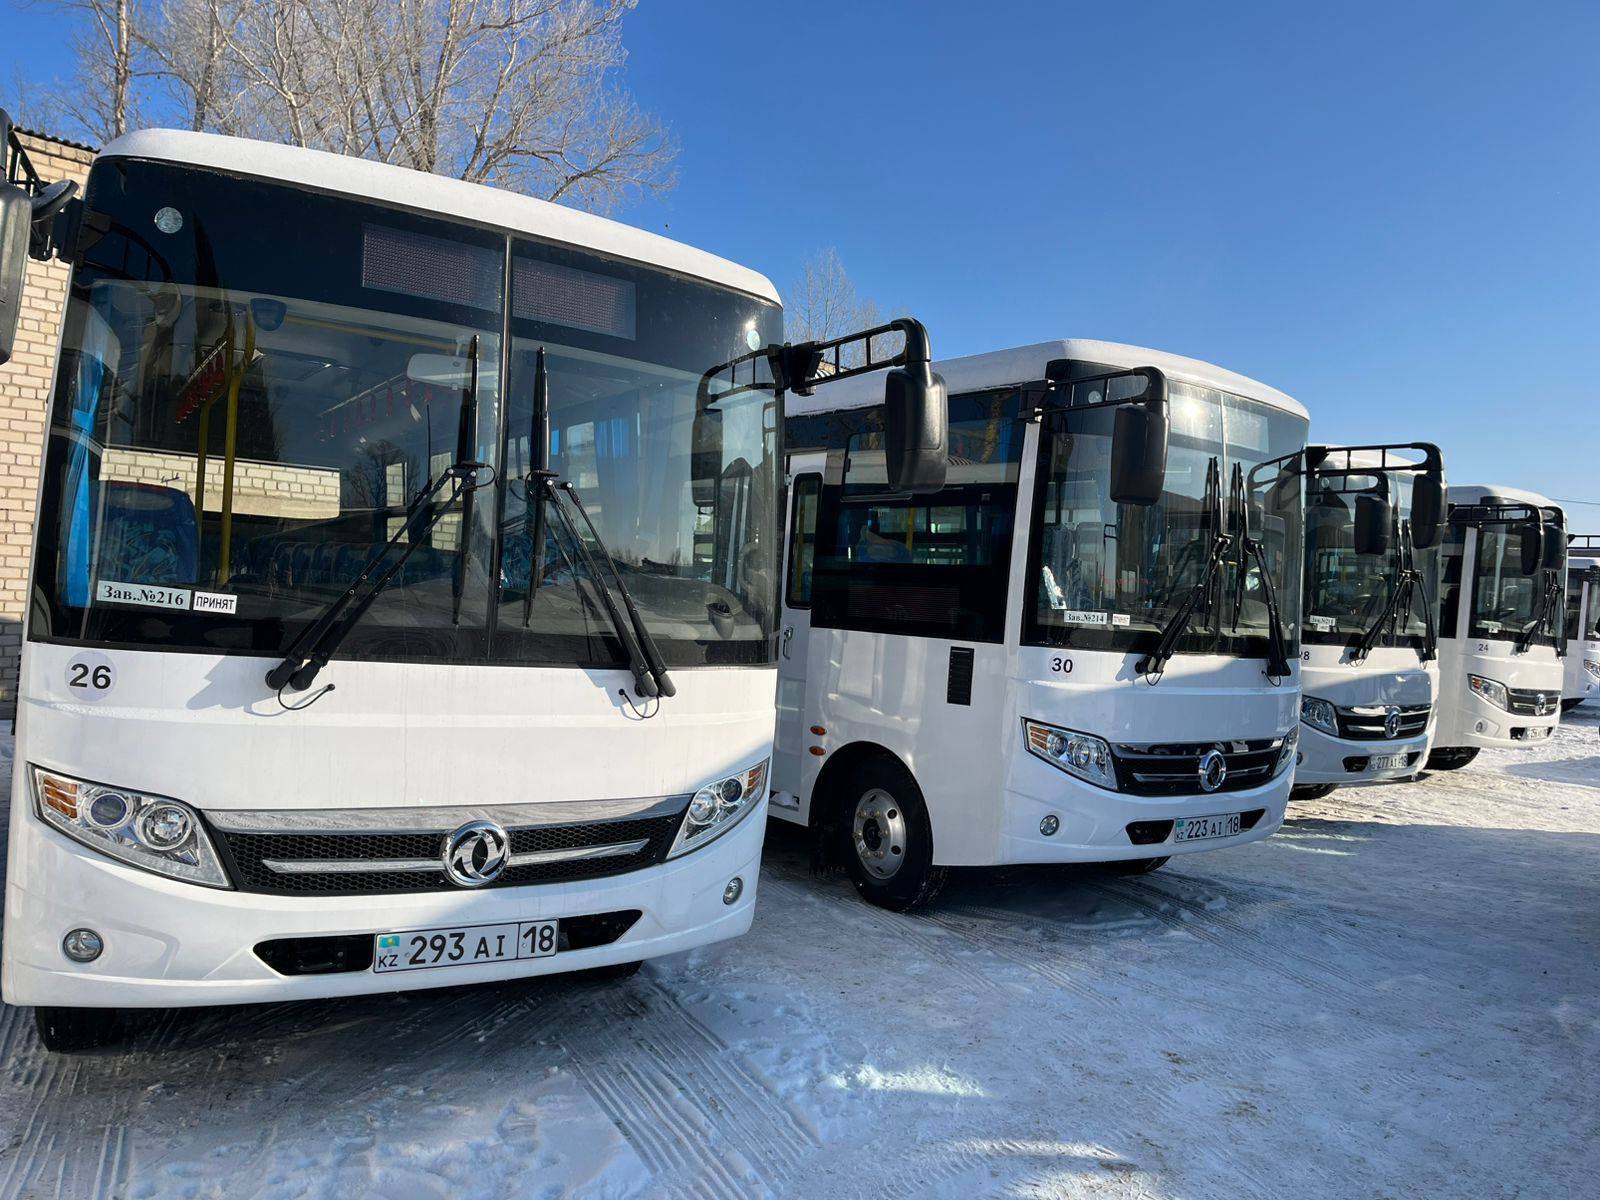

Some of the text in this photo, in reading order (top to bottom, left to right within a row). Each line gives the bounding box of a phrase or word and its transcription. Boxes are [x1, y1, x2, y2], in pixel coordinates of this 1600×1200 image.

[195, 596, 235, 610] ПРИНЯТ
[1478, 643, 1489, 652] 24
[1051, 657, 1073, 673] 30
[69, 663, 112, 689] 26
[1187, 819, 1208, 839] 223
[1210, 821, 1222, 836] AI
[1227, 816, 1239, 834] 18
[378, 925, 555, 969] KZ 293 AI 18
